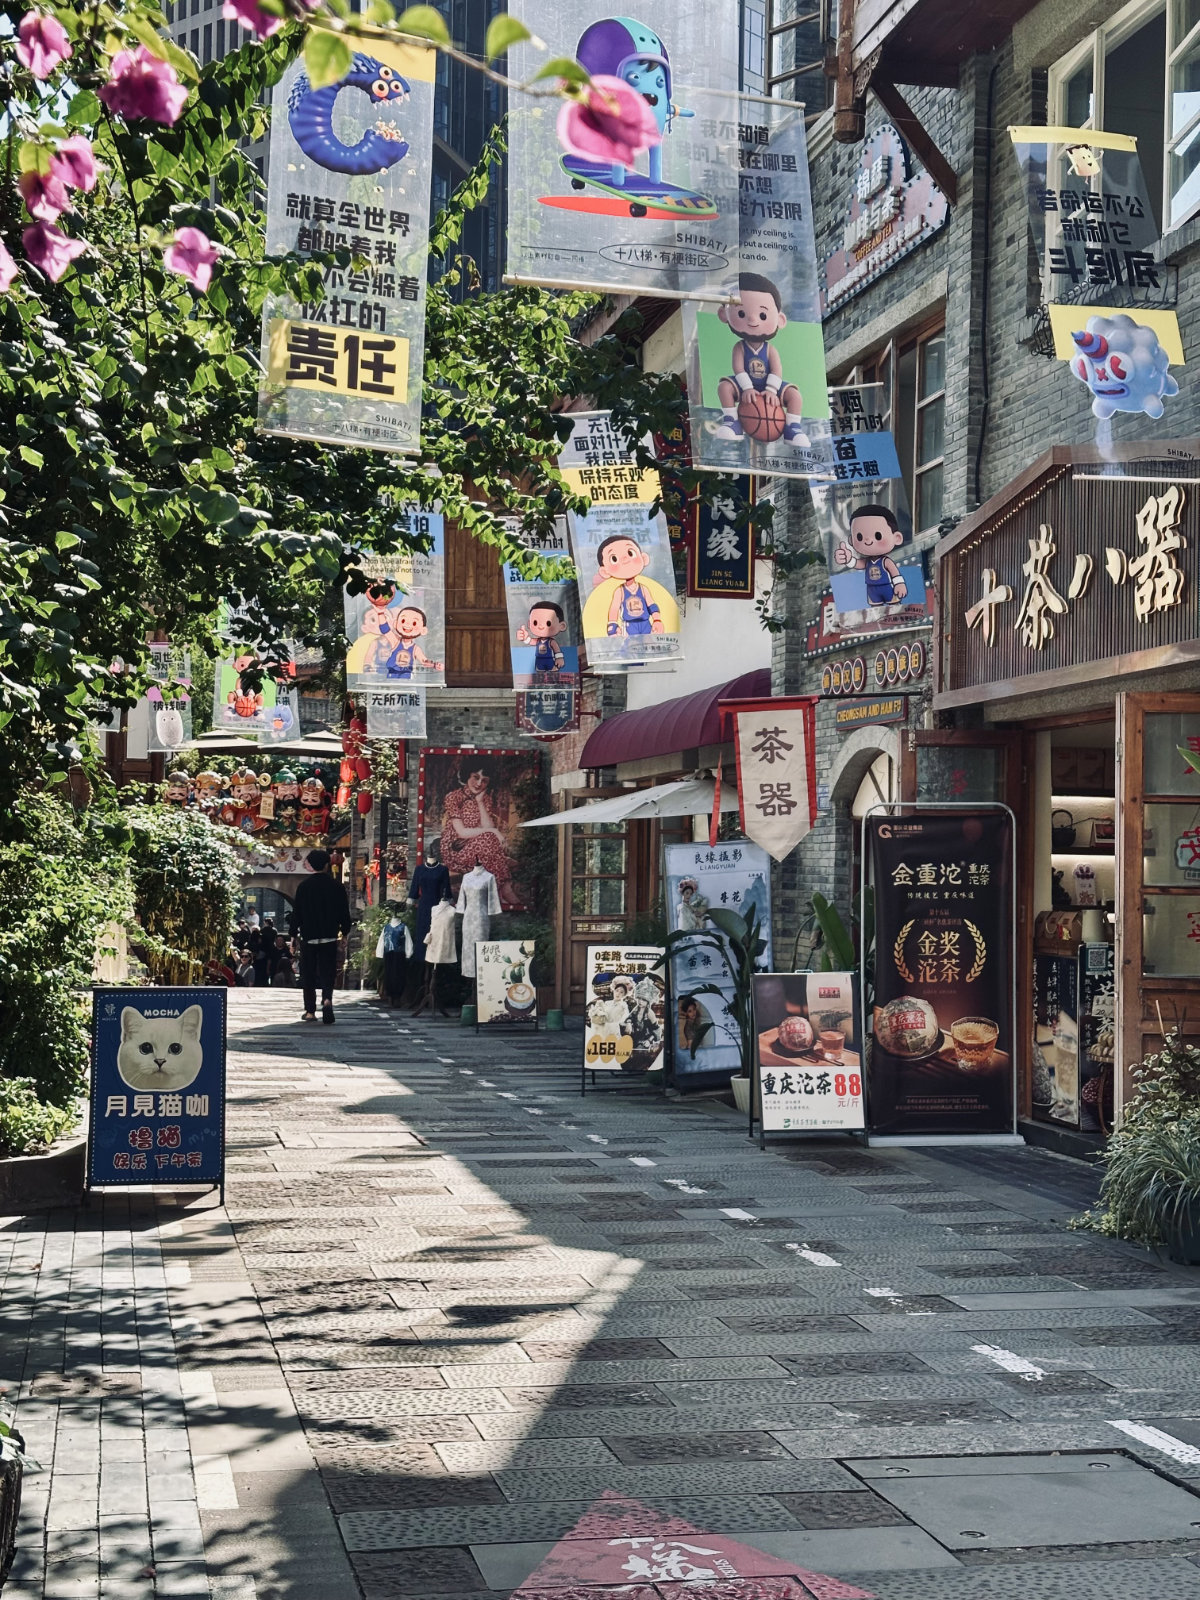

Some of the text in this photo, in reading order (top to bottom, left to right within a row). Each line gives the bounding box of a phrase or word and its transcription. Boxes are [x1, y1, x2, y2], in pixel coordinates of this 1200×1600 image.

[1035, 188, 1145, 219] 若命运不公
[286, 192, 410, 238] 就算全世界
[1060, 216, 1132, 245] 就和它
[676, 232, 728, 253] SHIBATI
[1048, 245, 1161, 288] 斗到底
[285, 325, 397, 396] 责任
[375, 414, 412, 431] SHIBATI
[573, 434, 635, 451] 面对什
[1167, 448, 1195, 461] SHIBATI
[590, 483, 640, 501] 的态度
[371, 692, 421, 707] 无所不能
[867, 703, 880, 717] AND
[751, 726, 798, 817] 茶器
[891, 862, 990, 887] 金重沱 重庆
[917, 930, 961, 956] 金奖
[594, 950, 621, 962] 0套路
[594, 962, 648, 974] 无二次消费
[917, 958, 961, 984] 沱茶
[143, 1009, 181, 1017] MOCHA
[761, 1071, 861, 1097] 重庆沱茶 88
[104, 1093, 210, 1118] 月見猫咖
[838, 1097, 859, 1108] 元/斤
[113, 1152, 202, 1169] 娱乐 下午茶
